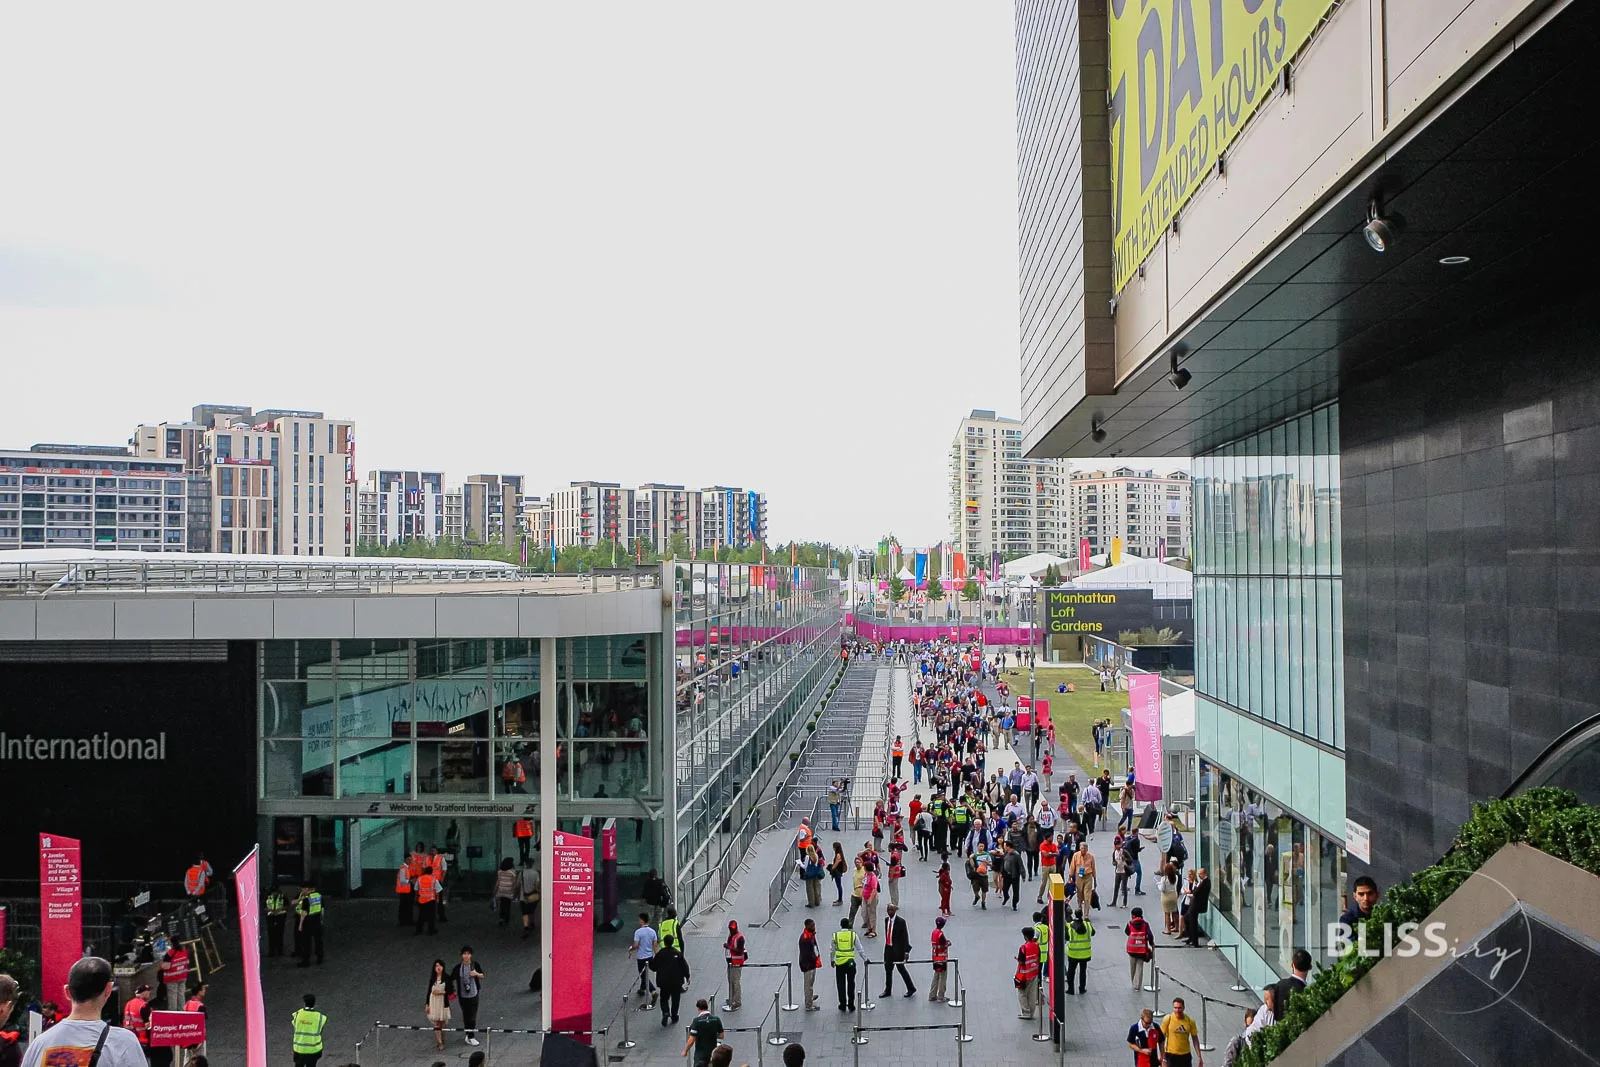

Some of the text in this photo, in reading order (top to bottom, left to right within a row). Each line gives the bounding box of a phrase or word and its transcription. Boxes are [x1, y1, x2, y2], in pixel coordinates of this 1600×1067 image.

[1115, 0, 1286, 286] WITH EXTENDED HOURS
[1050, 592, 1116, 603] Manhattan
[1050, 606, 1075, 617] Loft
[1050, 620, 1103, 632] Gardens
[0, 732, 166, 760] International
[389, 803, 514, 812] Welcome to Stratford International
